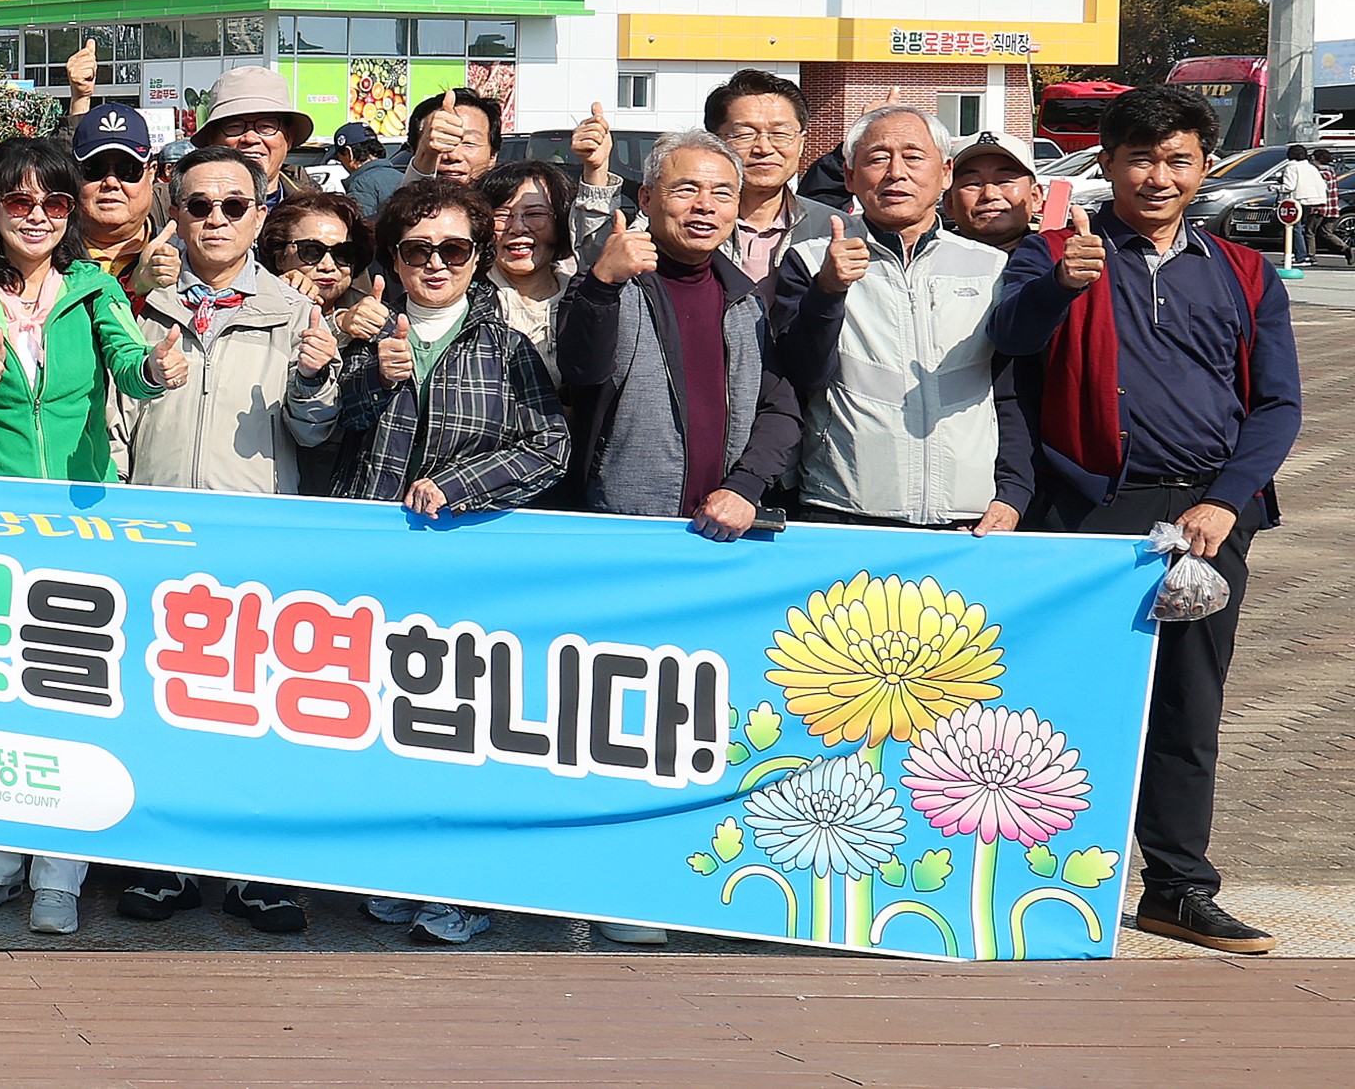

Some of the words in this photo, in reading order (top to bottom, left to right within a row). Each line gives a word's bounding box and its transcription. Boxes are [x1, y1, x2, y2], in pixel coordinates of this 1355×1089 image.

[993, 33, 1030, 53] 직매장
[1200, 83, 1233, 97] VIP
[153, 581, 719, 779] 환영합니다!
[13, 789, 62, 809] COUNTY
